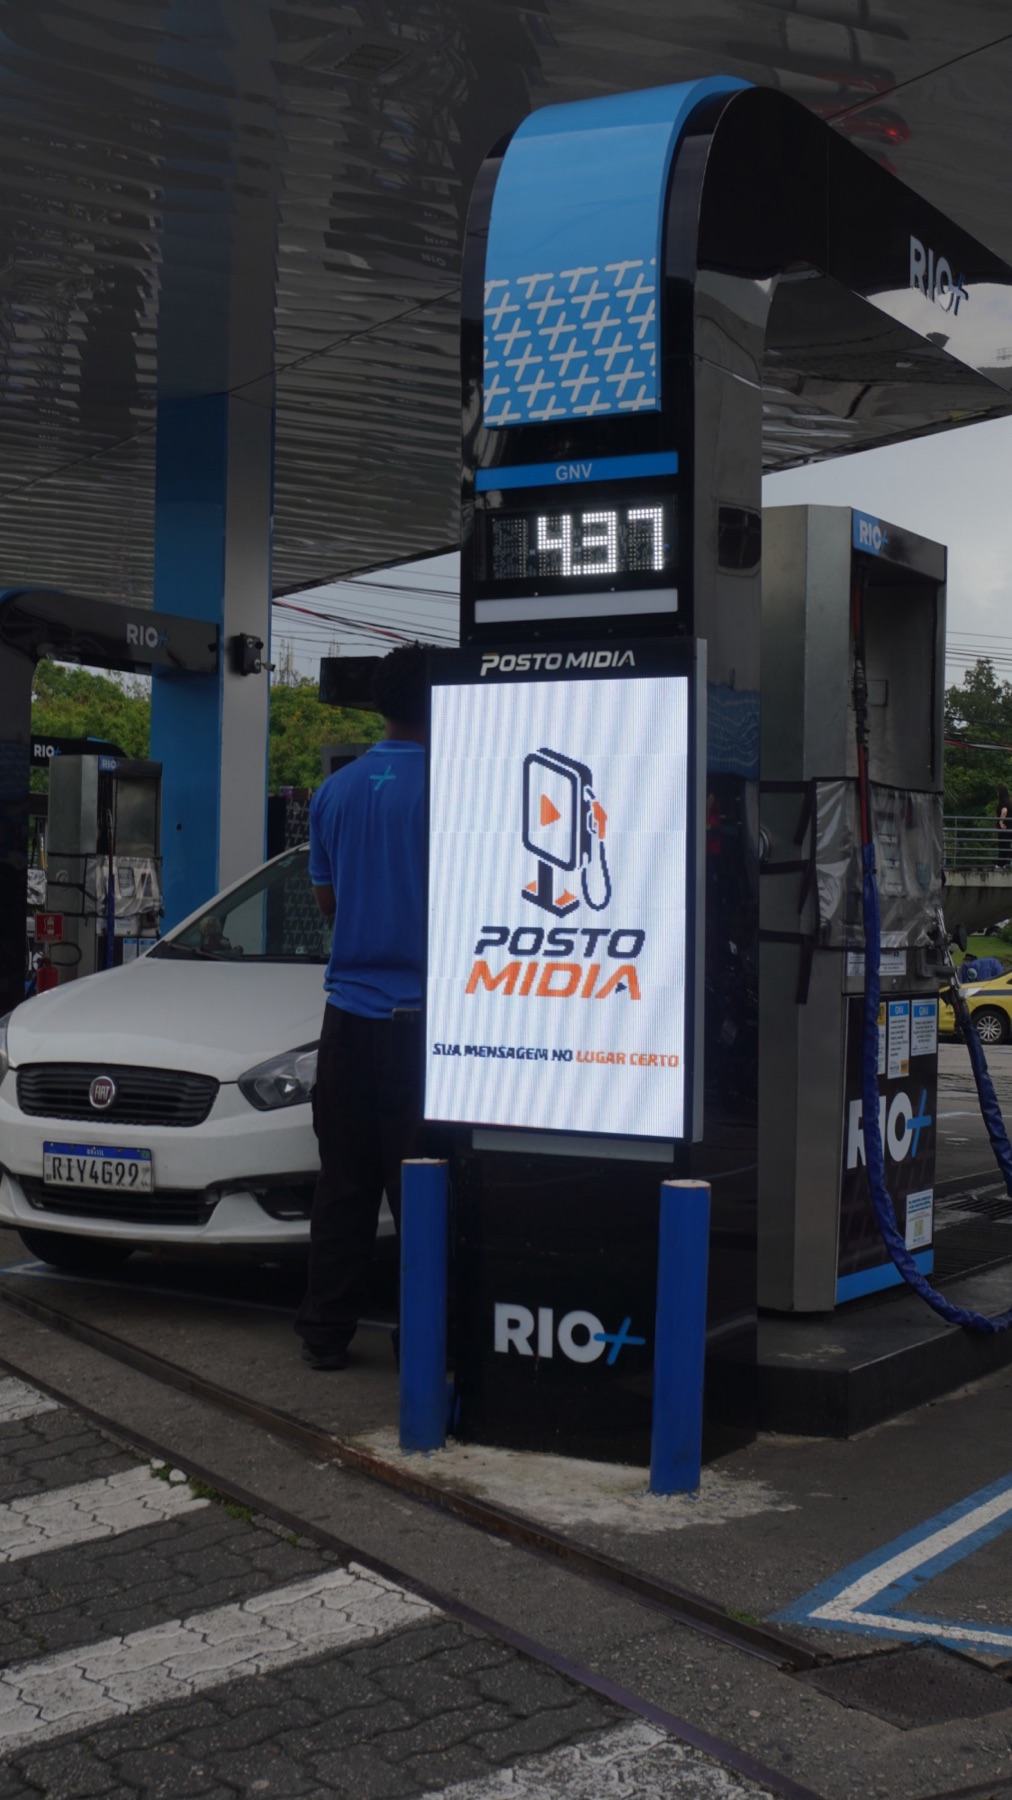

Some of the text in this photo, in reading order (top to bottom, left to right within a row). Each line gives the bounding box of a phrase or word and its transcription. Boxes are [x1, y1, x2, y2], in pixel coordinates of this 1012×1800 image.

[555, 463, 593, 482] GNV
[480, 650, 636, 677] POSTO MIDIA
[474, 925, 646, 959] POSTO
[465, 960, 642, 1001] MIDIA
[432, 1043, 680, 1067] SUA MENSAGEM NO LUGAR CERTO
[94, 1085, 111, 1101] FIAT
